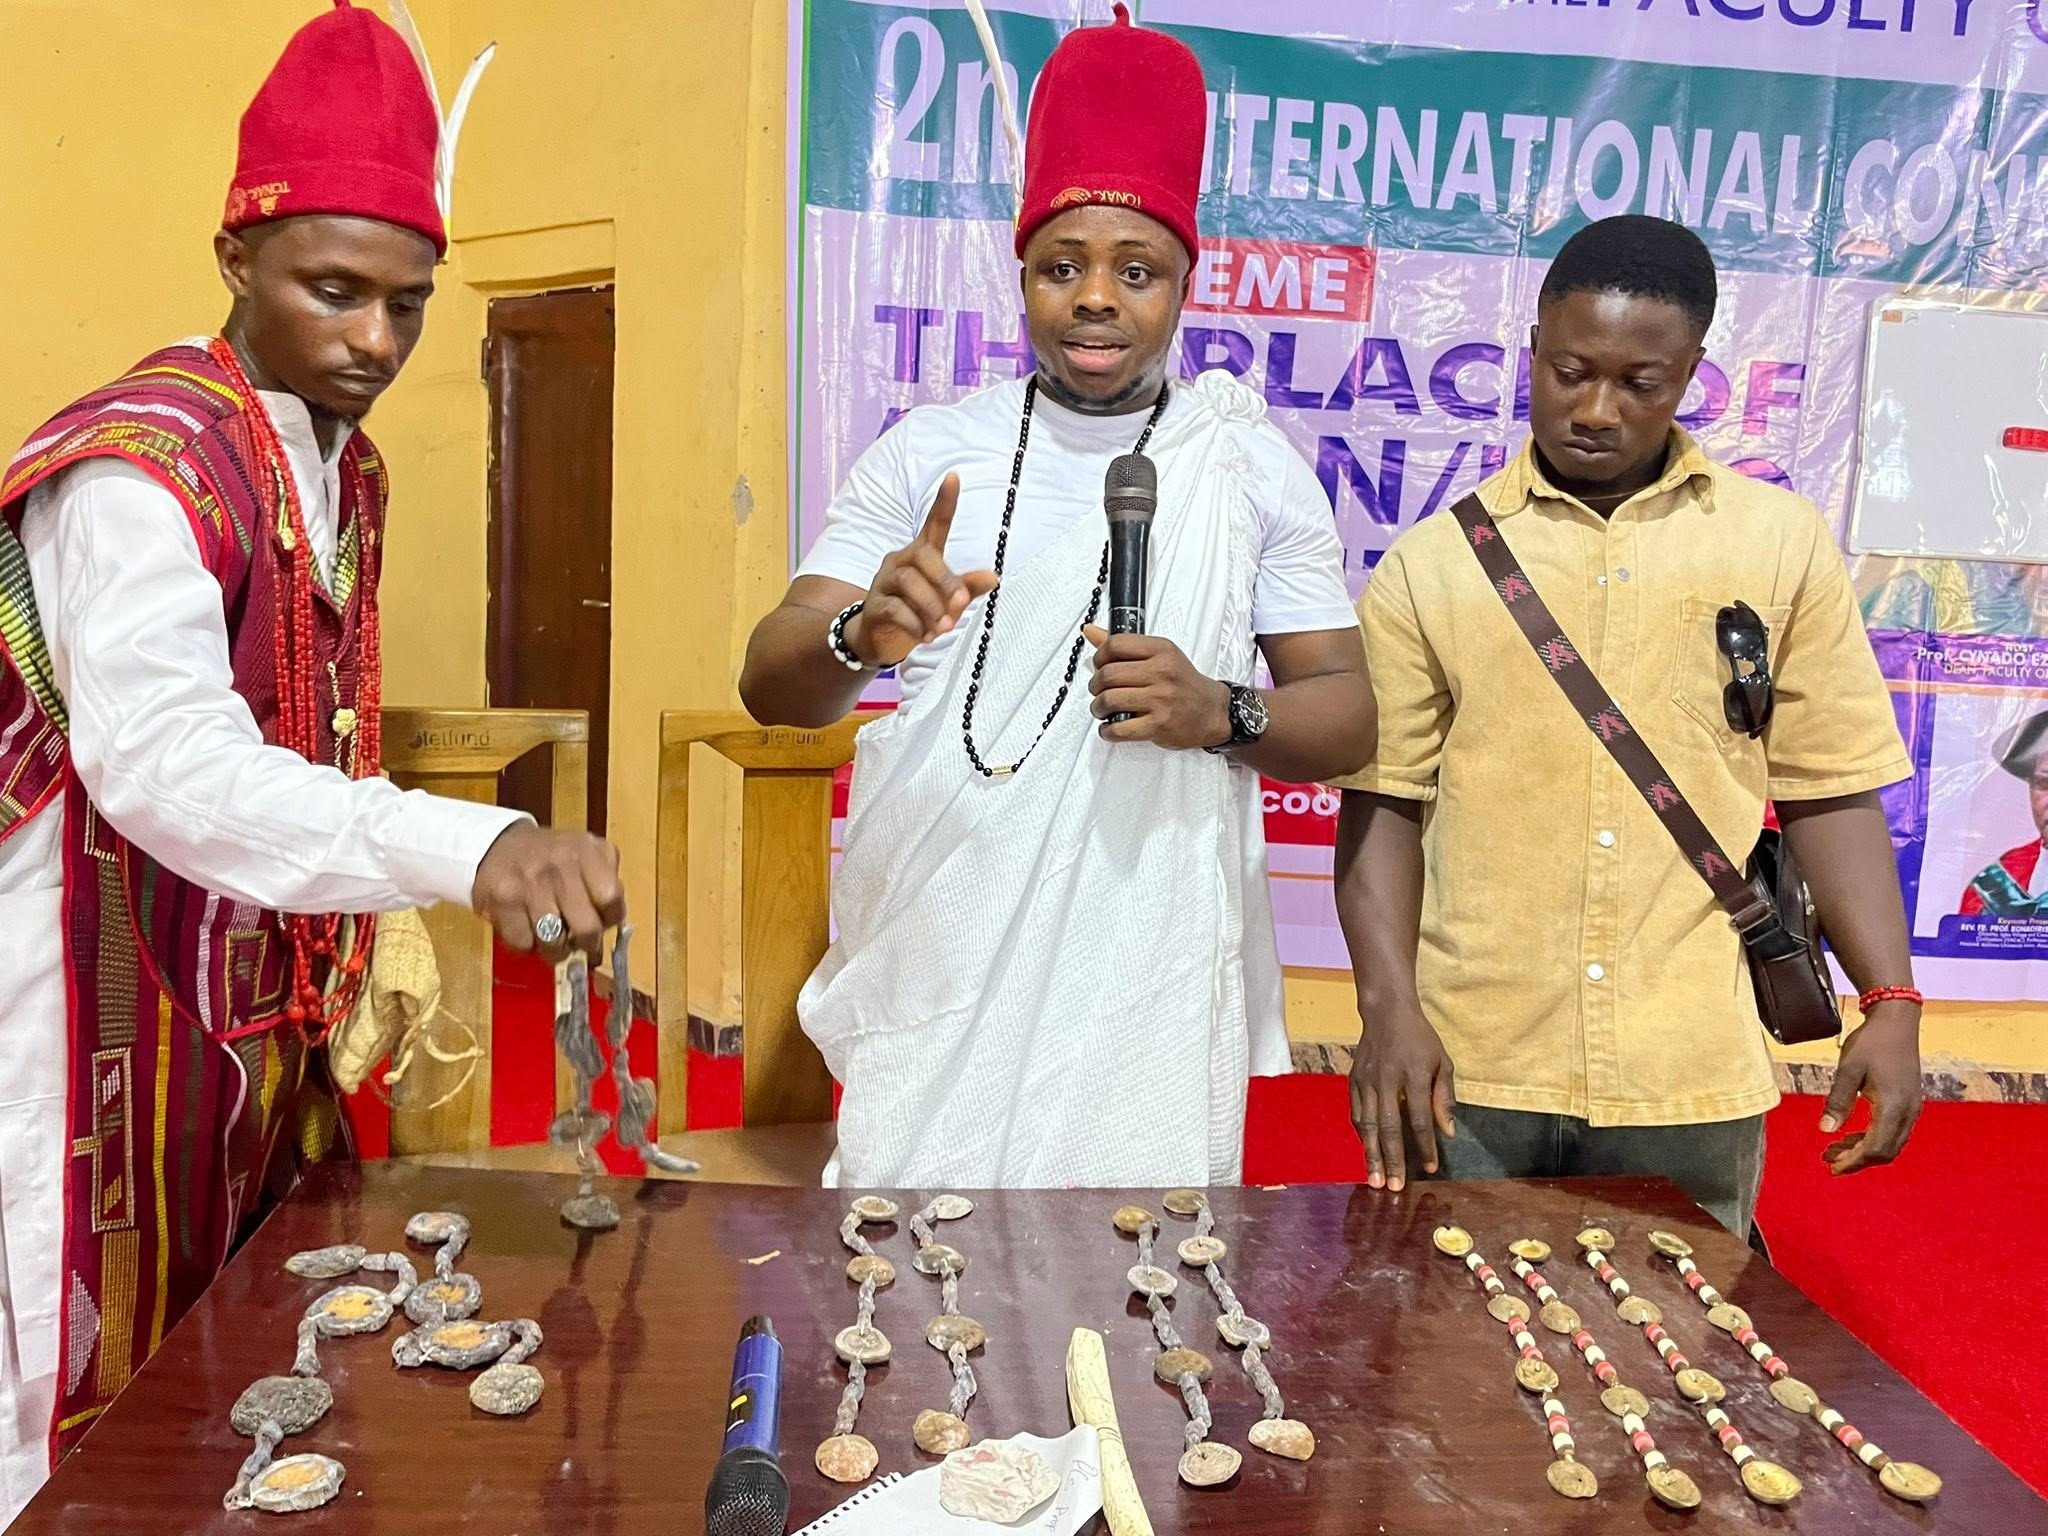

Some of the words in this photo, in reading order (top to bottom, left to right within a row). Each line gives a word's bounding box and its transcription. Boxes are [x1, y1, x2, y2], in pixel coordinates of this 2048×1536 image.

[876, 16, 1040, 184] 2n
[1844, 139, 2048, 247] CON
[1983, 665, 2031, 678] FACULTY
